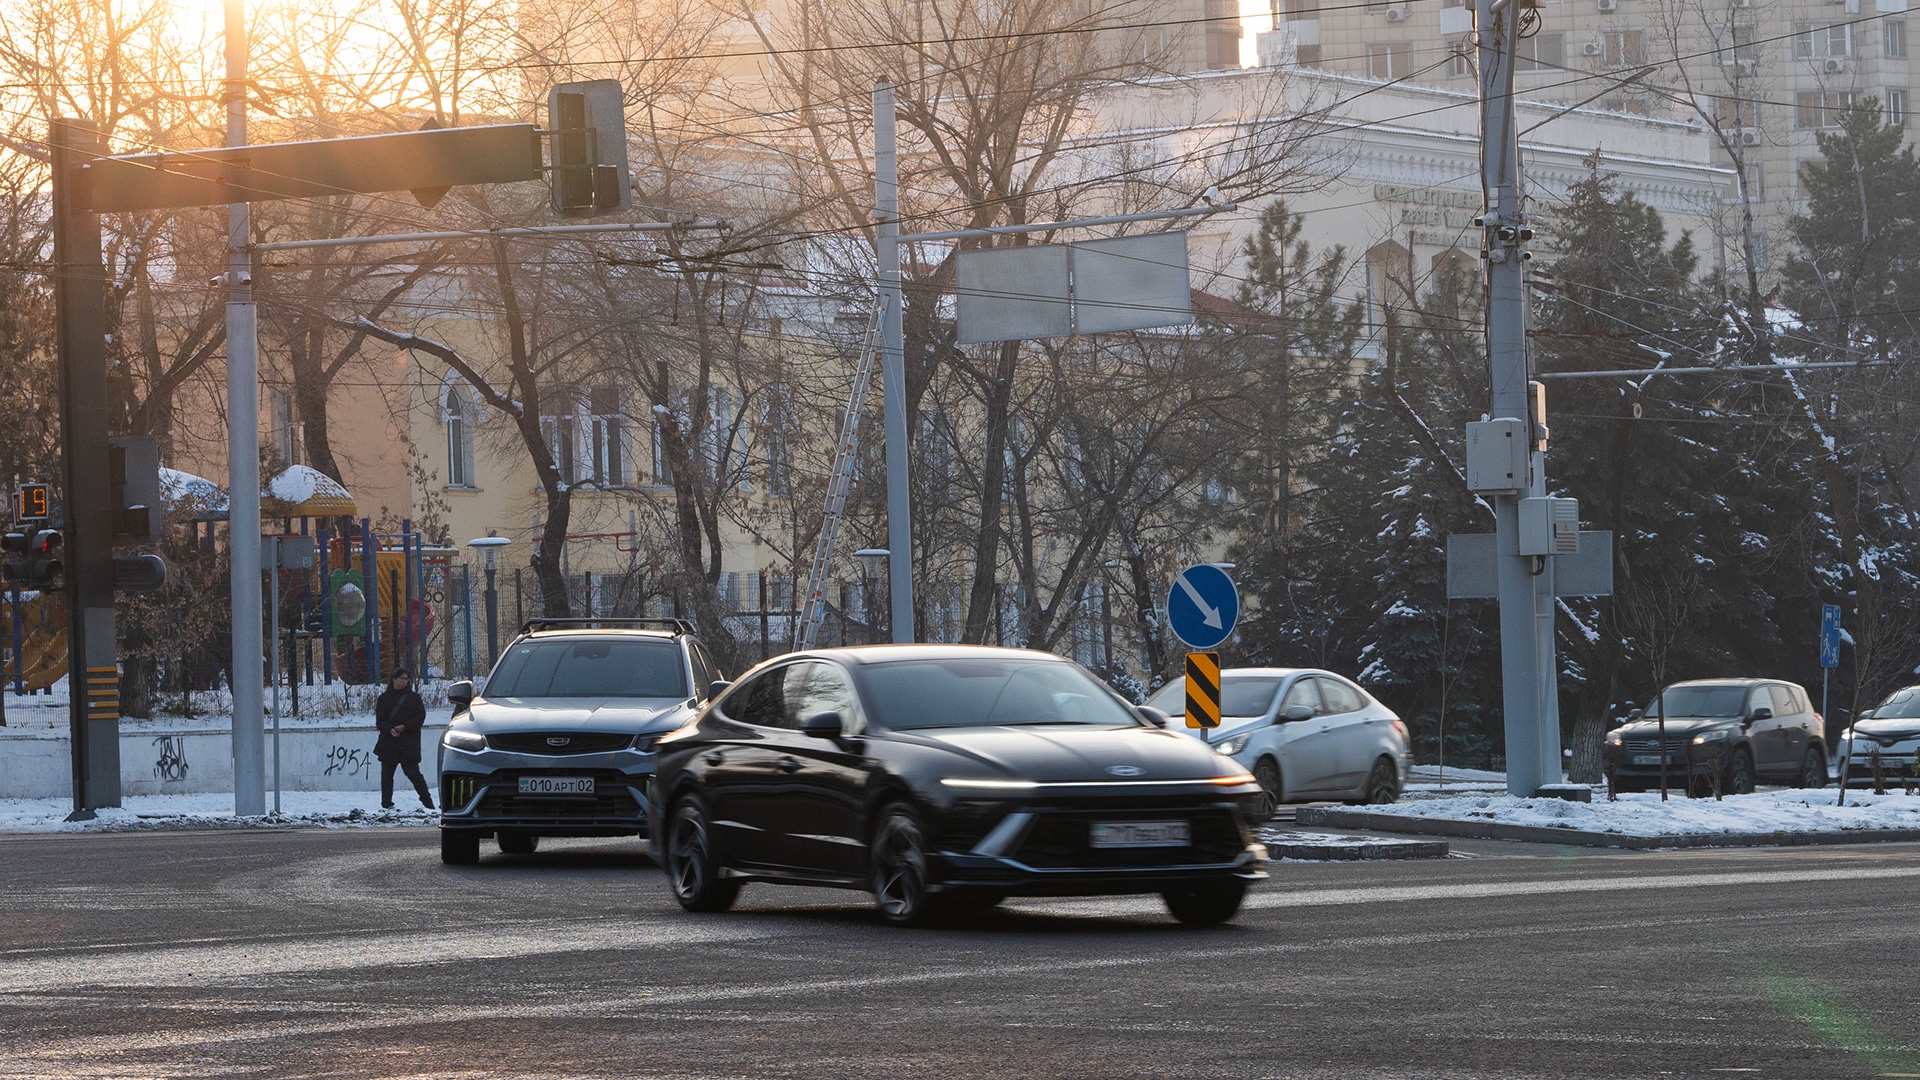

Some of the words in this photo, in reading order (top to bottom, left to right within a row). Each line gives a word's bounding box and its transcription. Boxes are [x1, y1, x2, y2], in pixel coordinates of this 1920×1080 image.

[21, 488, 45, 514] 19
[324, 745, 371, 780] 1954
[530, 780, 552, 791] 010
[554, 782, 575, 791] APT
[578, 780, 593, 791] 02
